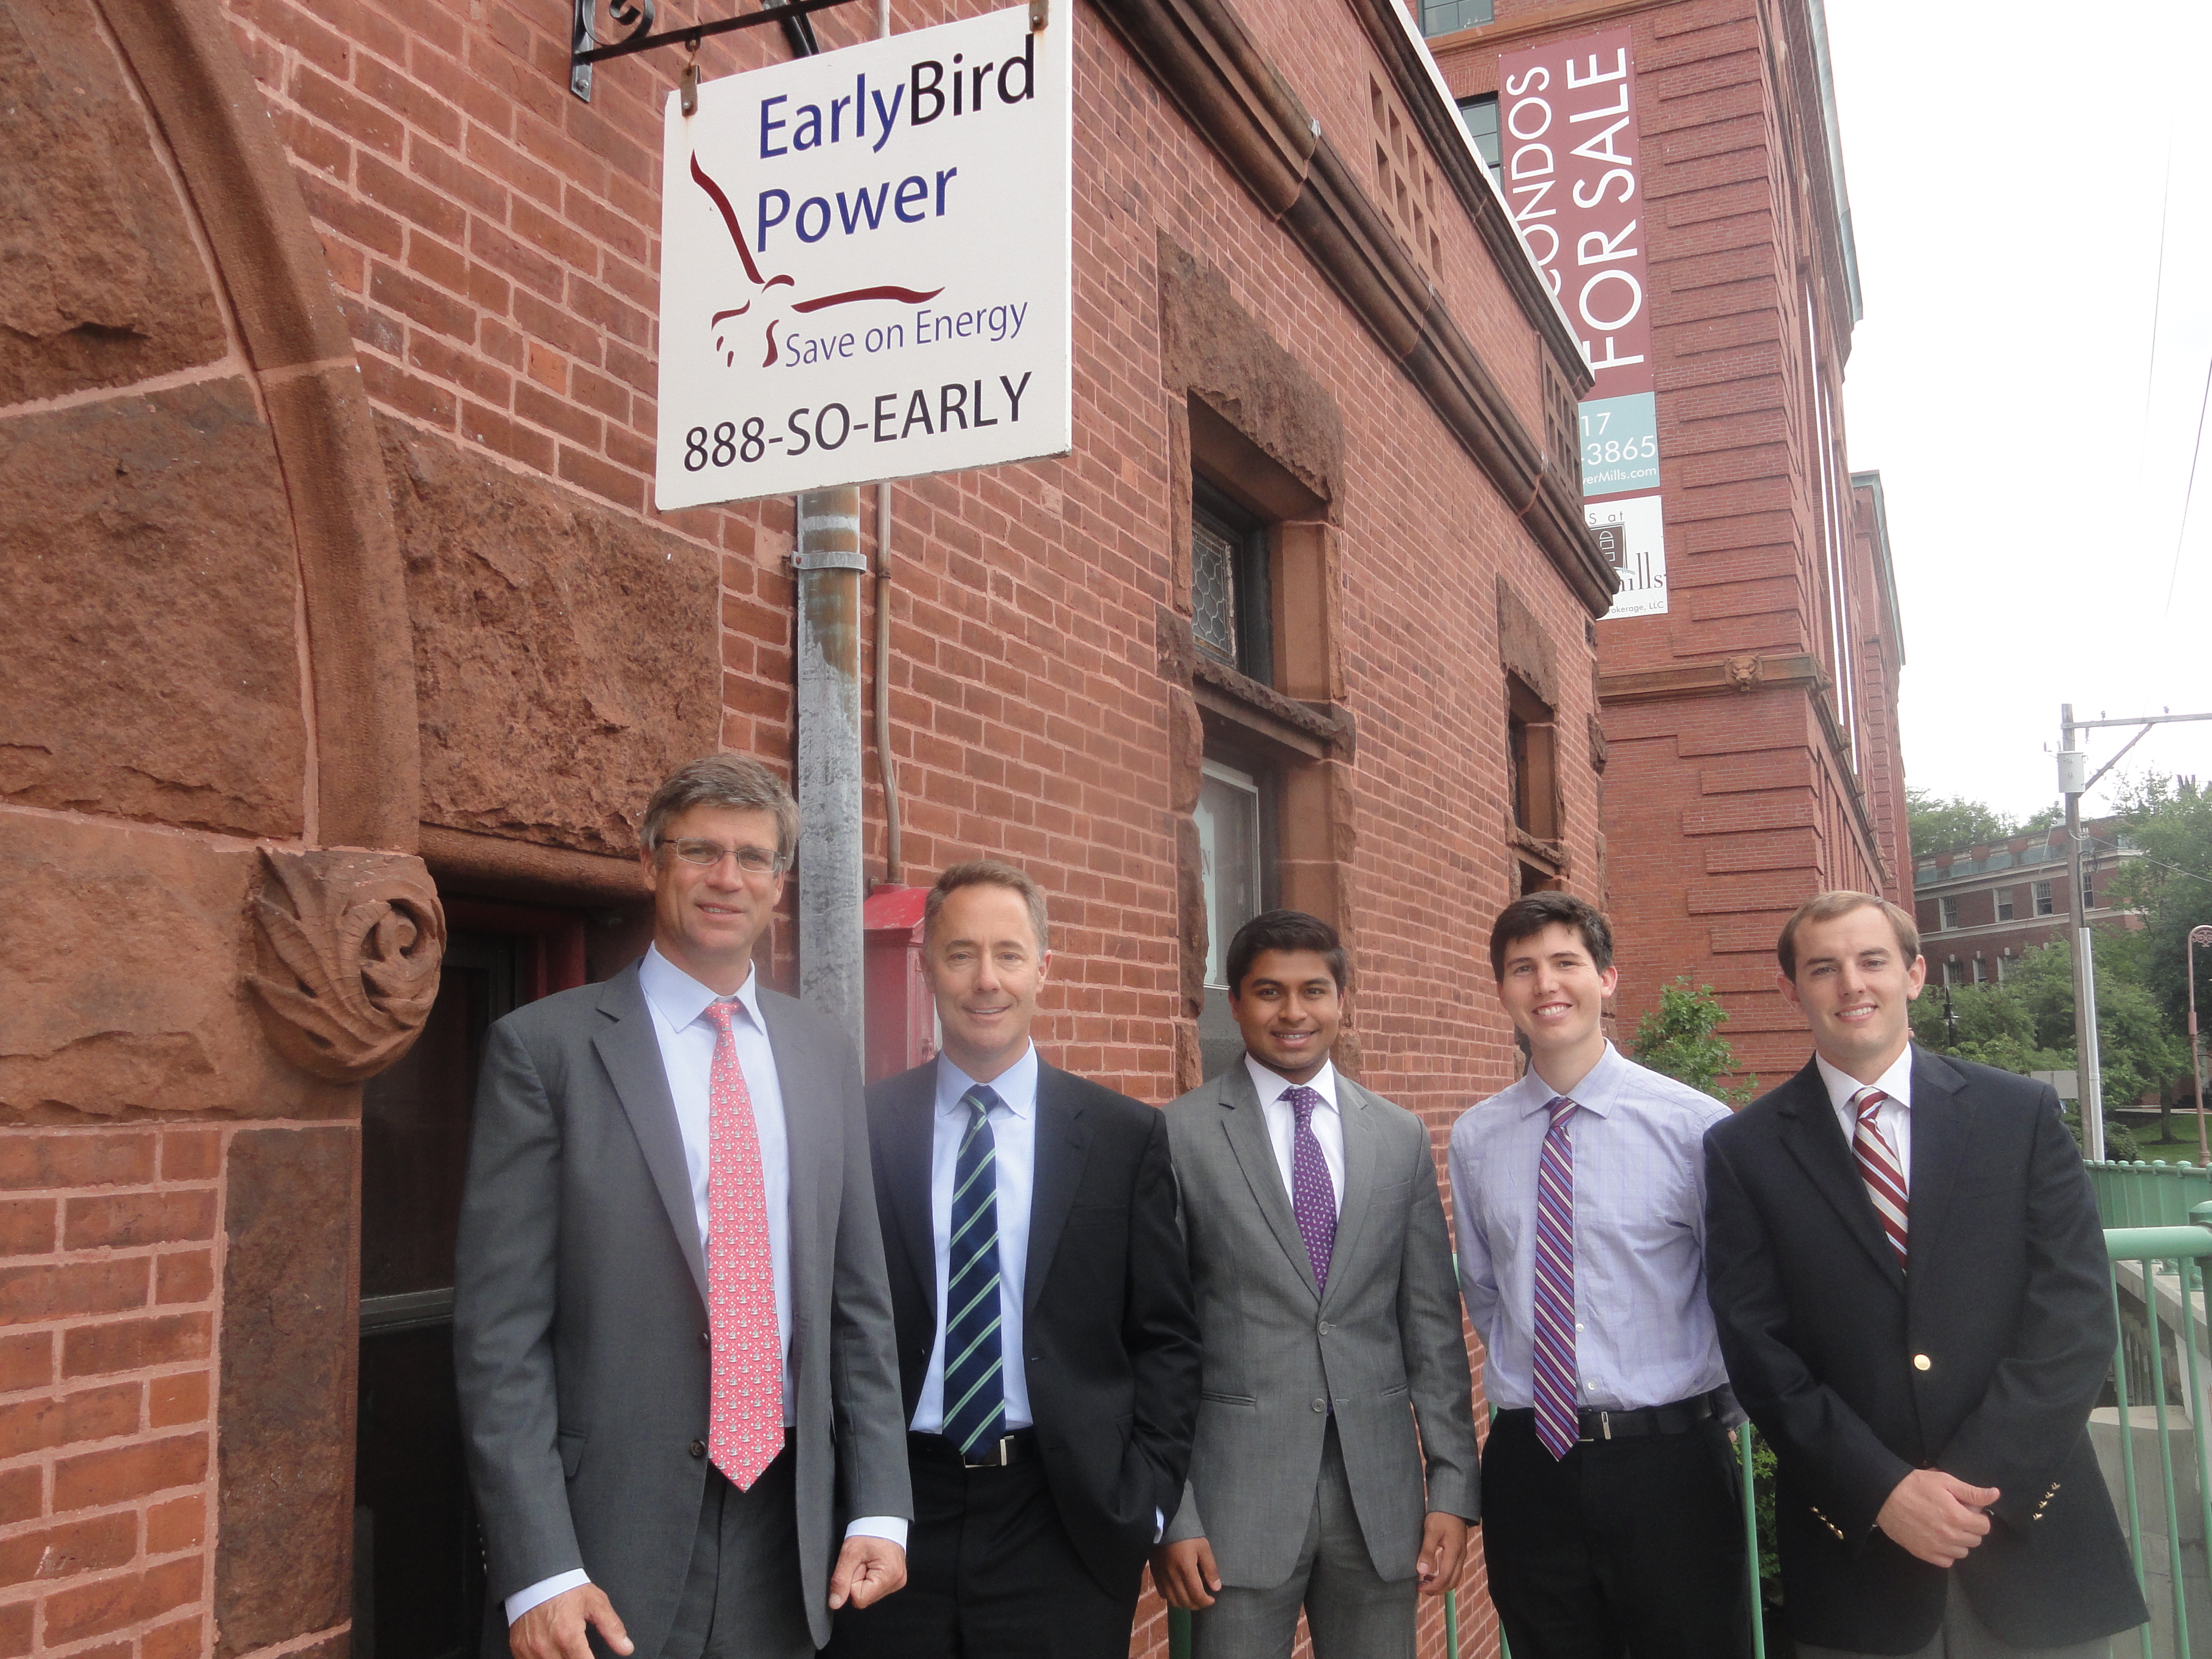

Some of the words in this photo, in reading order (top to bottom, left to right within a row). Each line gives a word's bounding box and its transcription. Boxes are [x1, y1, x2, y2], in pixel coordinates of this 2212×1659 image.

[760, 33, 1035, 159] EarlyBird
[1566, 48, 1635, 208] SALE
[757, 167, 957, 252] Power
[785, 333, 855, 368] Save
[865, 324, 904, 353] on
[917, 302, 1028, 345] Energy
[1577, 219, 1644, 371] FOR
[684, 371, 1032, 472] 888-SO-EARLY
[1581, 412, 1611, 436] 17
[1649, 601, 1664, 609] LLC
